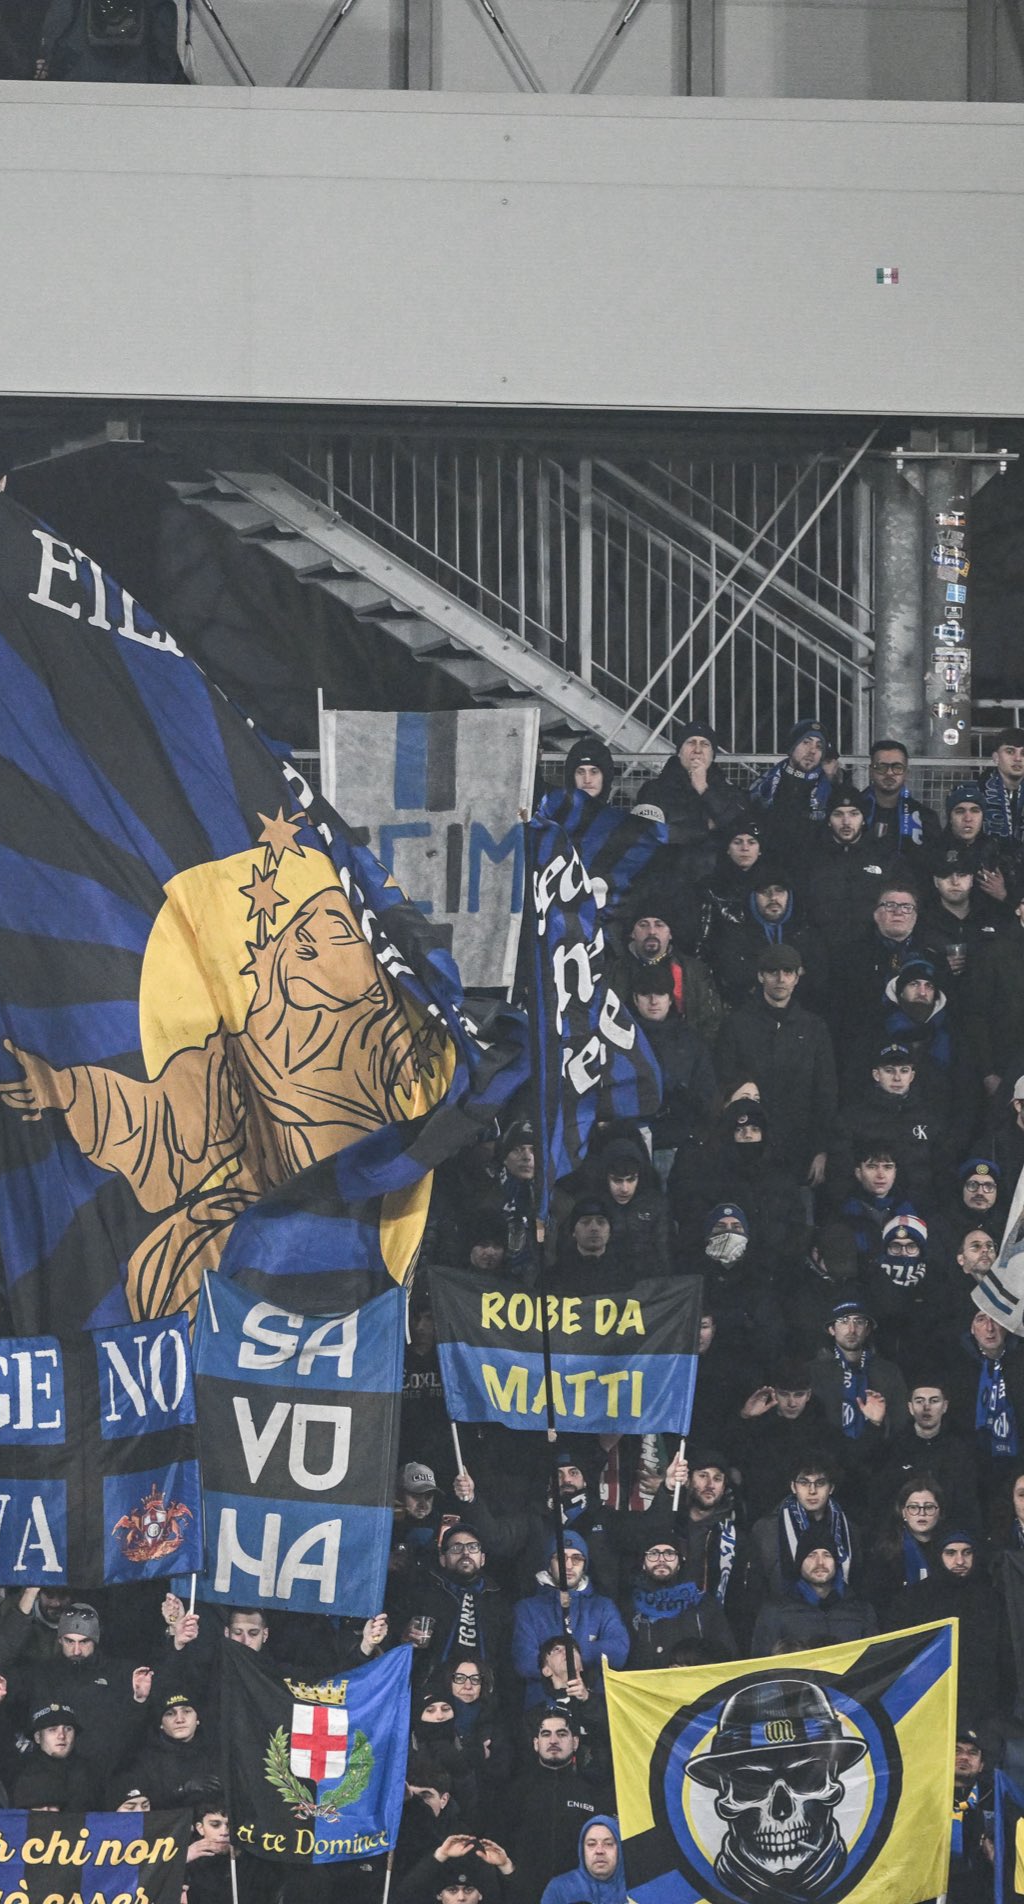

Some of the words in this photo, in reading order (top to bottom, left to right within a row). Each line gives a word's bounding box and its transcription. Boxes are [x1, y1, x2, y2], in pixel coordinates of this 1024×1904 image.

[237, 1301, 360, 1378] SA
[481, 1292, 583, 1335] ROBE
[594, 1298, 646, 1336] DA
[102, 1329, 188, 1422] NO
[481, 1363, 644, 1418] MATTI
[214, 1507, 343, 1604] NA
[21, 1828, 93, 1867] chi
[94, 1836, 179, 1867] non
[261, 1831, 287, 1853] te
